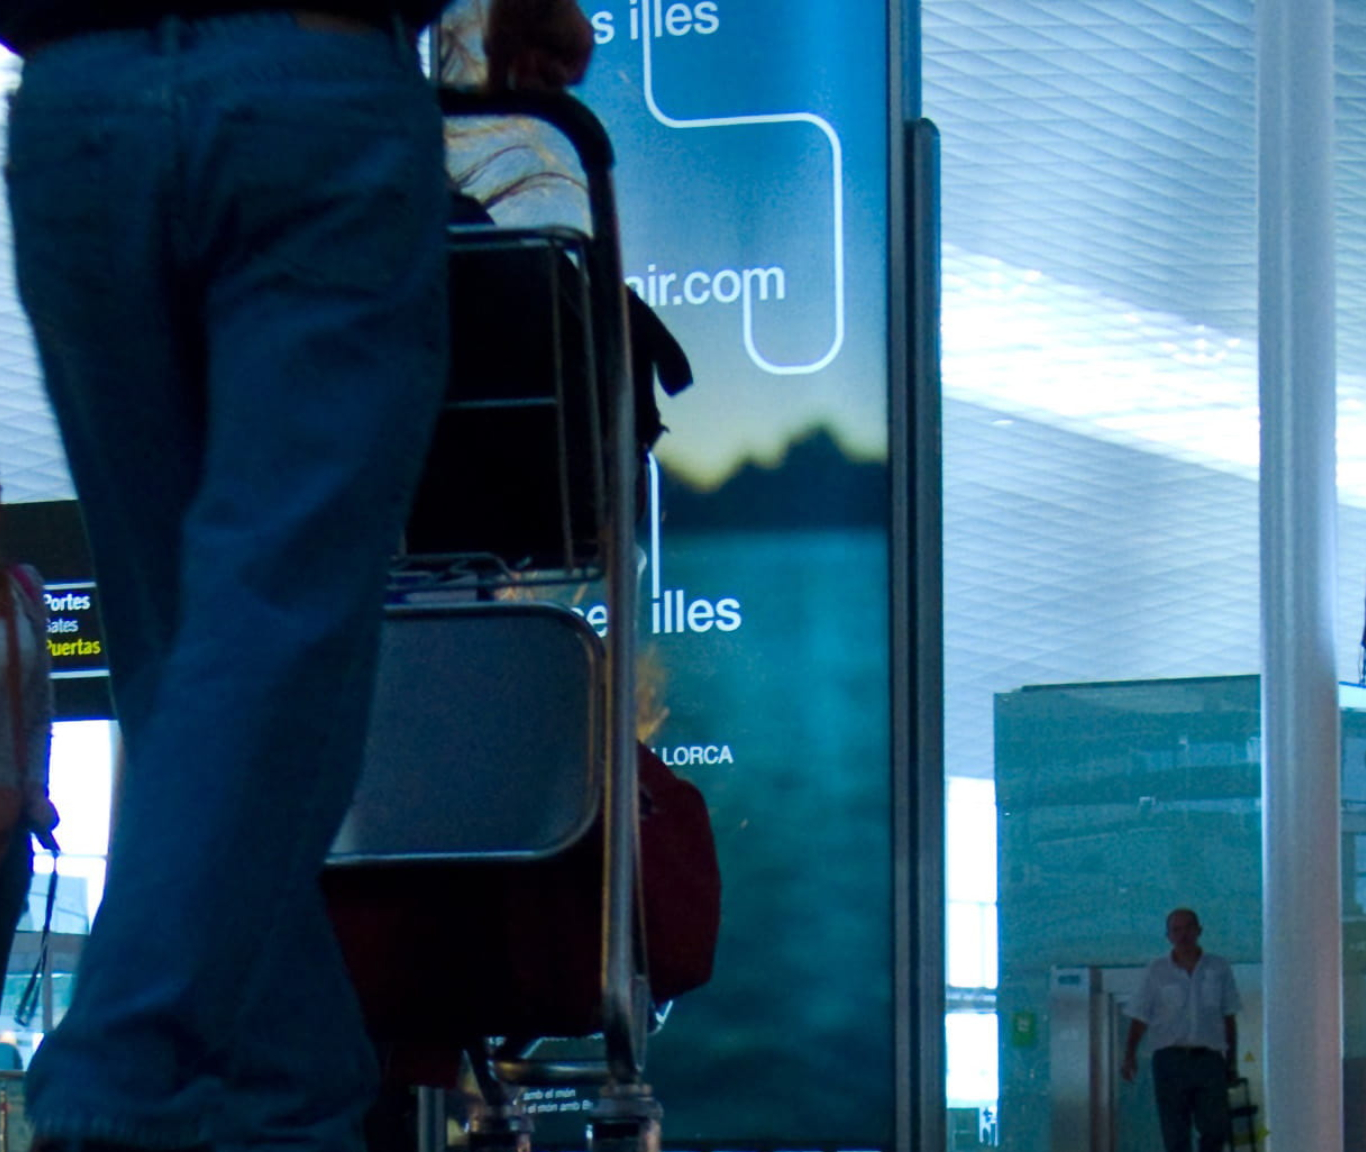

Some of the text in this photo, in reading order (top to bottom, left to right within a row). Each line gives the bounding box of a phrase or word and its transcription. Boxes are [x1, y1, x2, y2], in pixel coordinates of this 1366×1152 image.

[630, 0, 720, 41] illes
[652, 589, 742, 634] illes
[650, 745, 734, 766] LORCA
